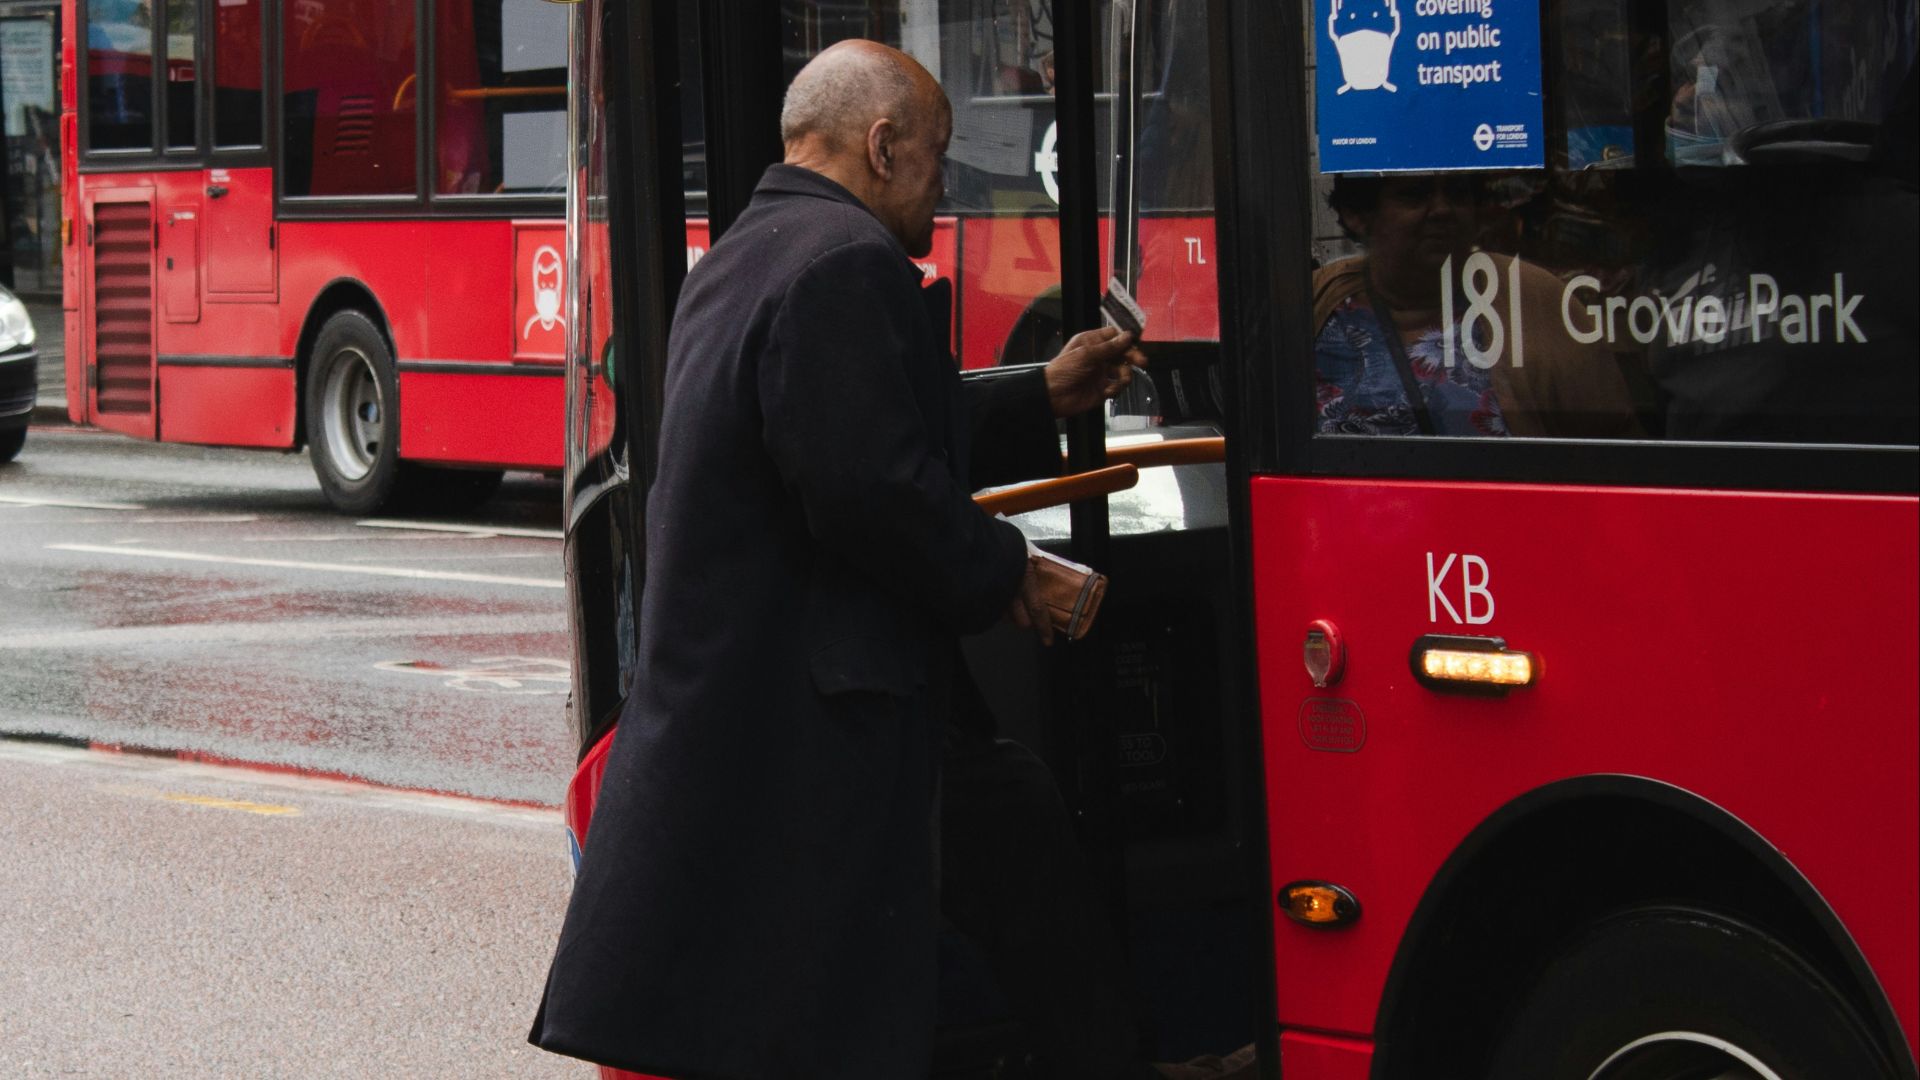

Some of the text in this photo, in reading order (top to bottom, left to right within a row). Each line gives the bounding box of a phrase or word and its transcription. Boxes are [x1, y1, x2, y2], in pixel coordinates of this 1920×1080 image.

[1416, 0, 1493, 18] covering
[1417, 24, 1501, 55] on public
[1417, 60, 1502, 89] transport
[1183, 237, 1206, 265] TL
[1441, 250, 1524, 370] 181
[1561, 275, 1727, 345] Grove
[1749, 272, 1868, 344] Park
[1426, 551, 1495, 625] KB
